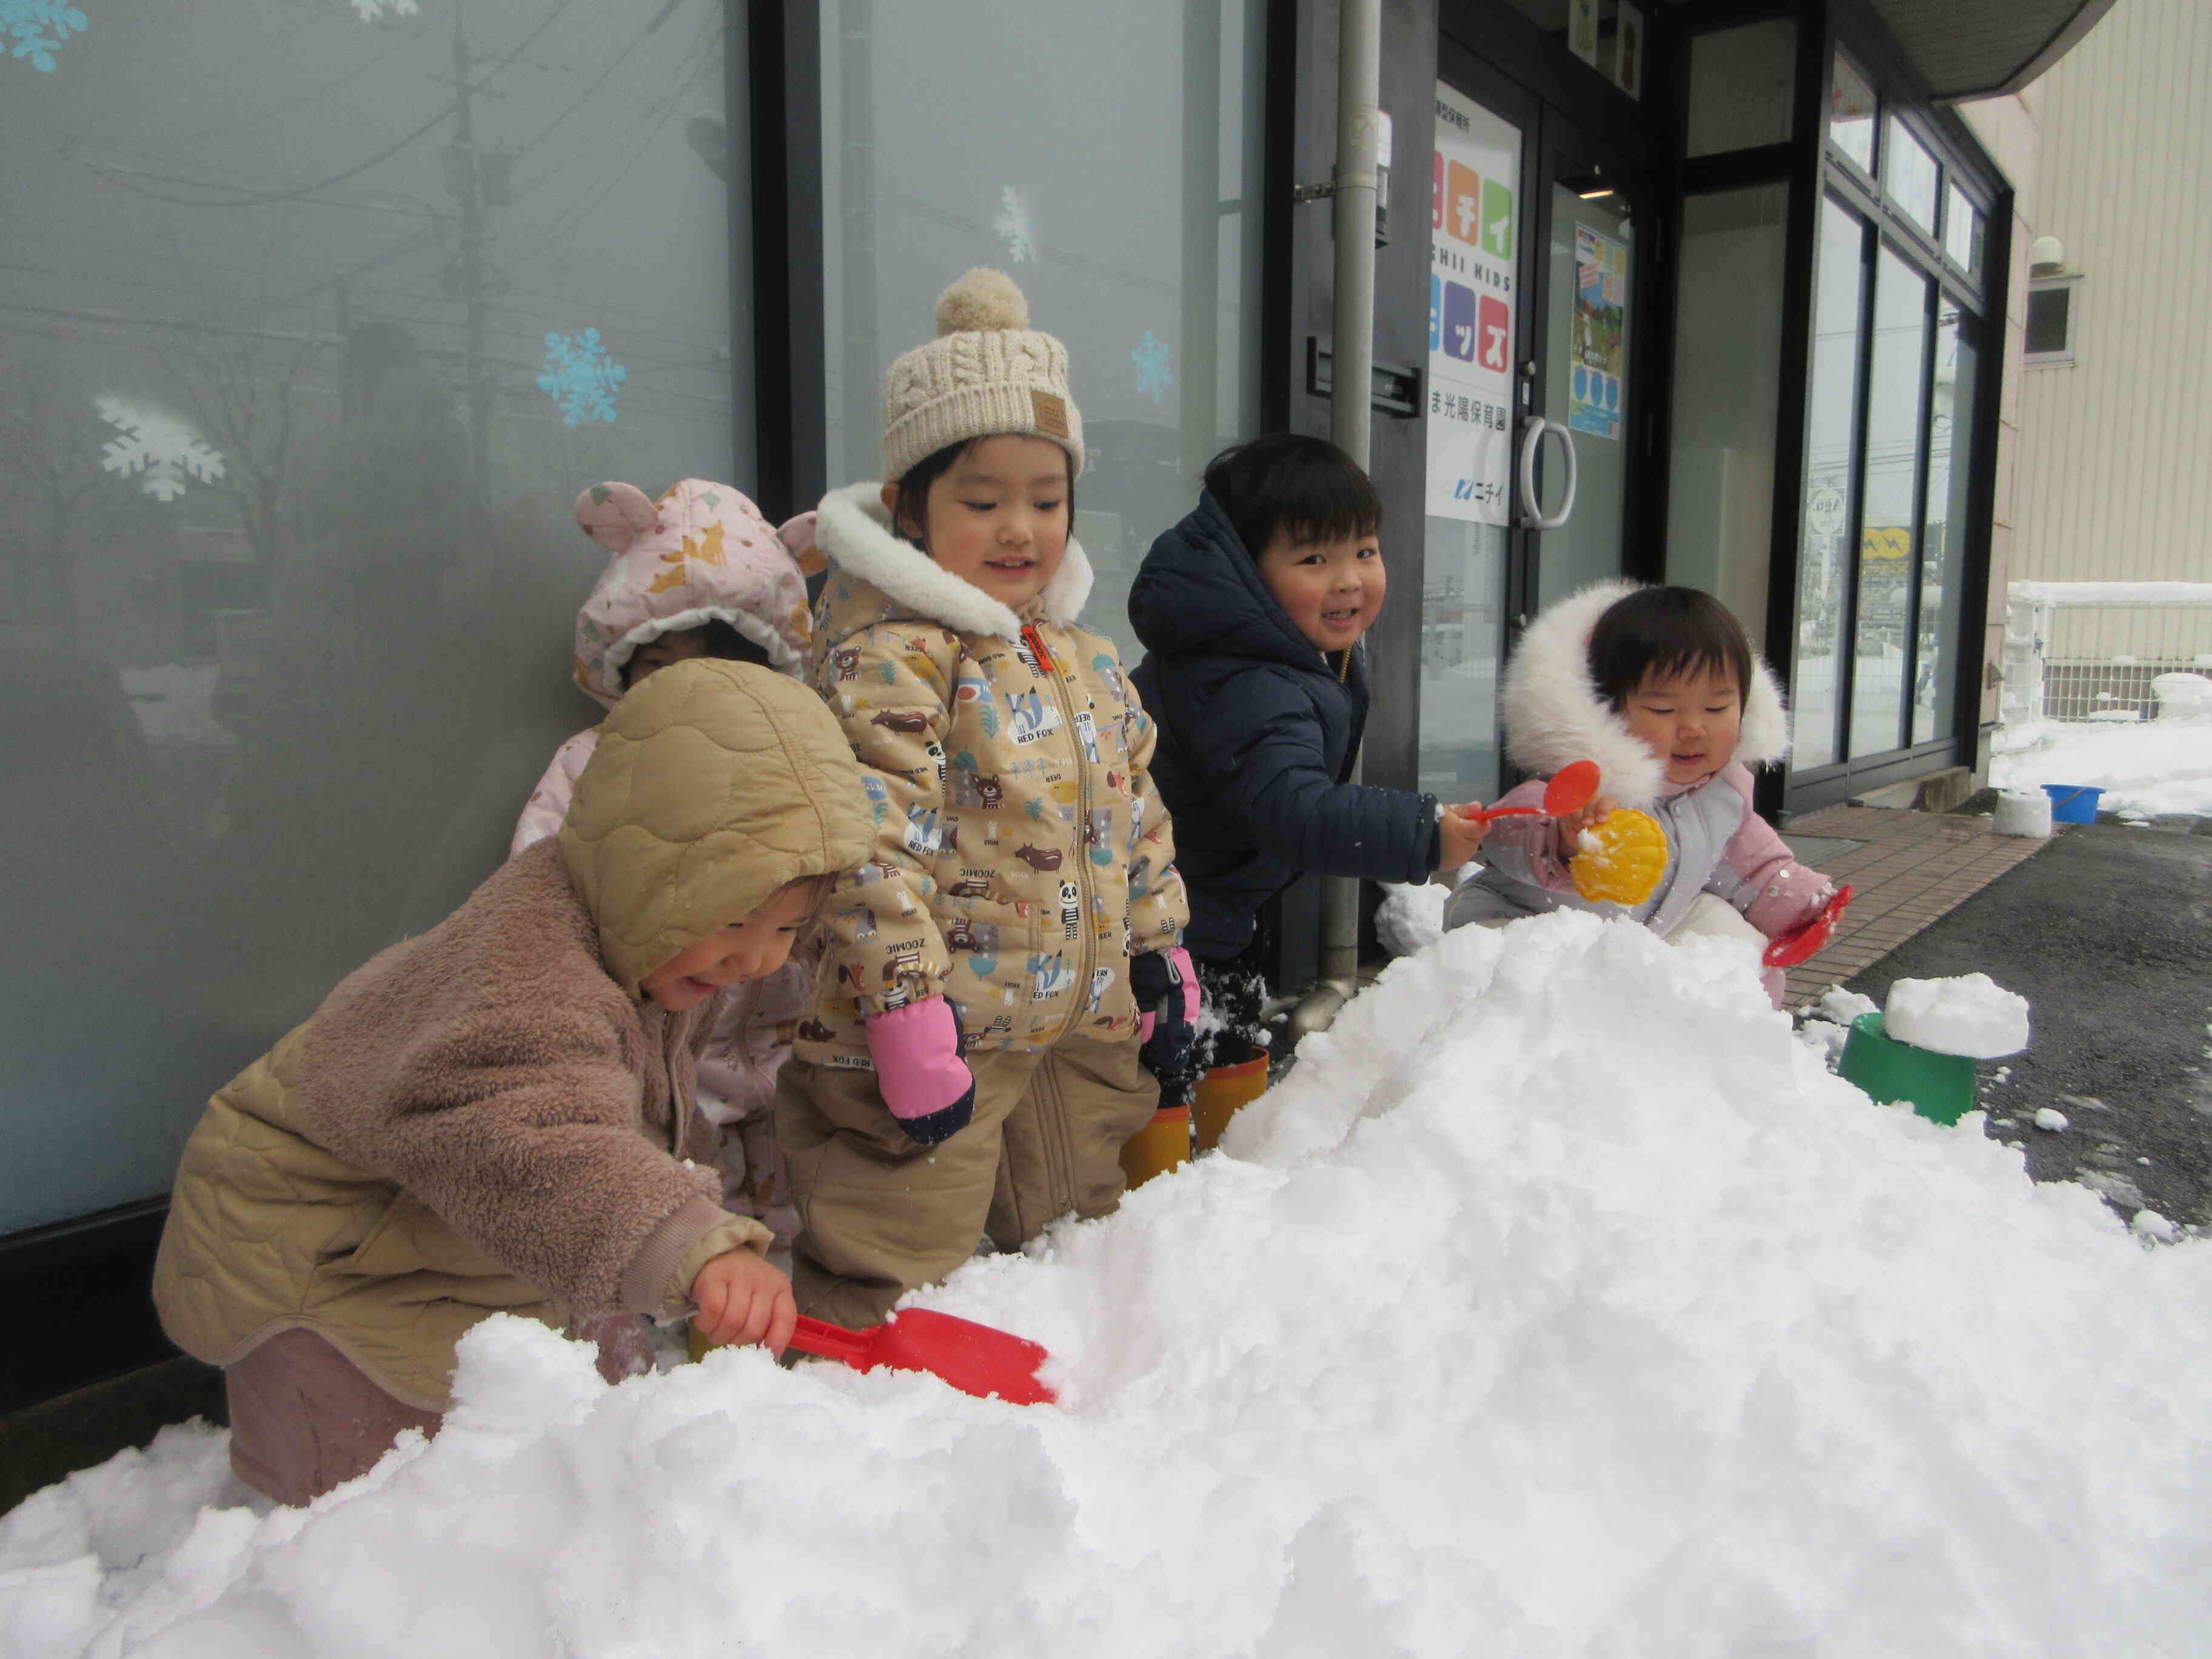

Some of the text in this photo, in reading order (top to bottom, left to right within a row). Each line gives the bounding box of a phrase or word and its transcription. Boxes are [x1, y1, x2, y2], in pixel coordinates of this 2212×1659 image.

[1475, 263, 1510, 292] KIDS
[1017, 728, 1054, 743] RED FOX
[908, 839, 922, 853] RED
[960, 868, 995, 878] ZOOMIC
[886, 937, 925, 955] ZOOMIC
[1045, 990, 1059, 999] FOX
[833, 1055, 870, 1067] RED FOX
